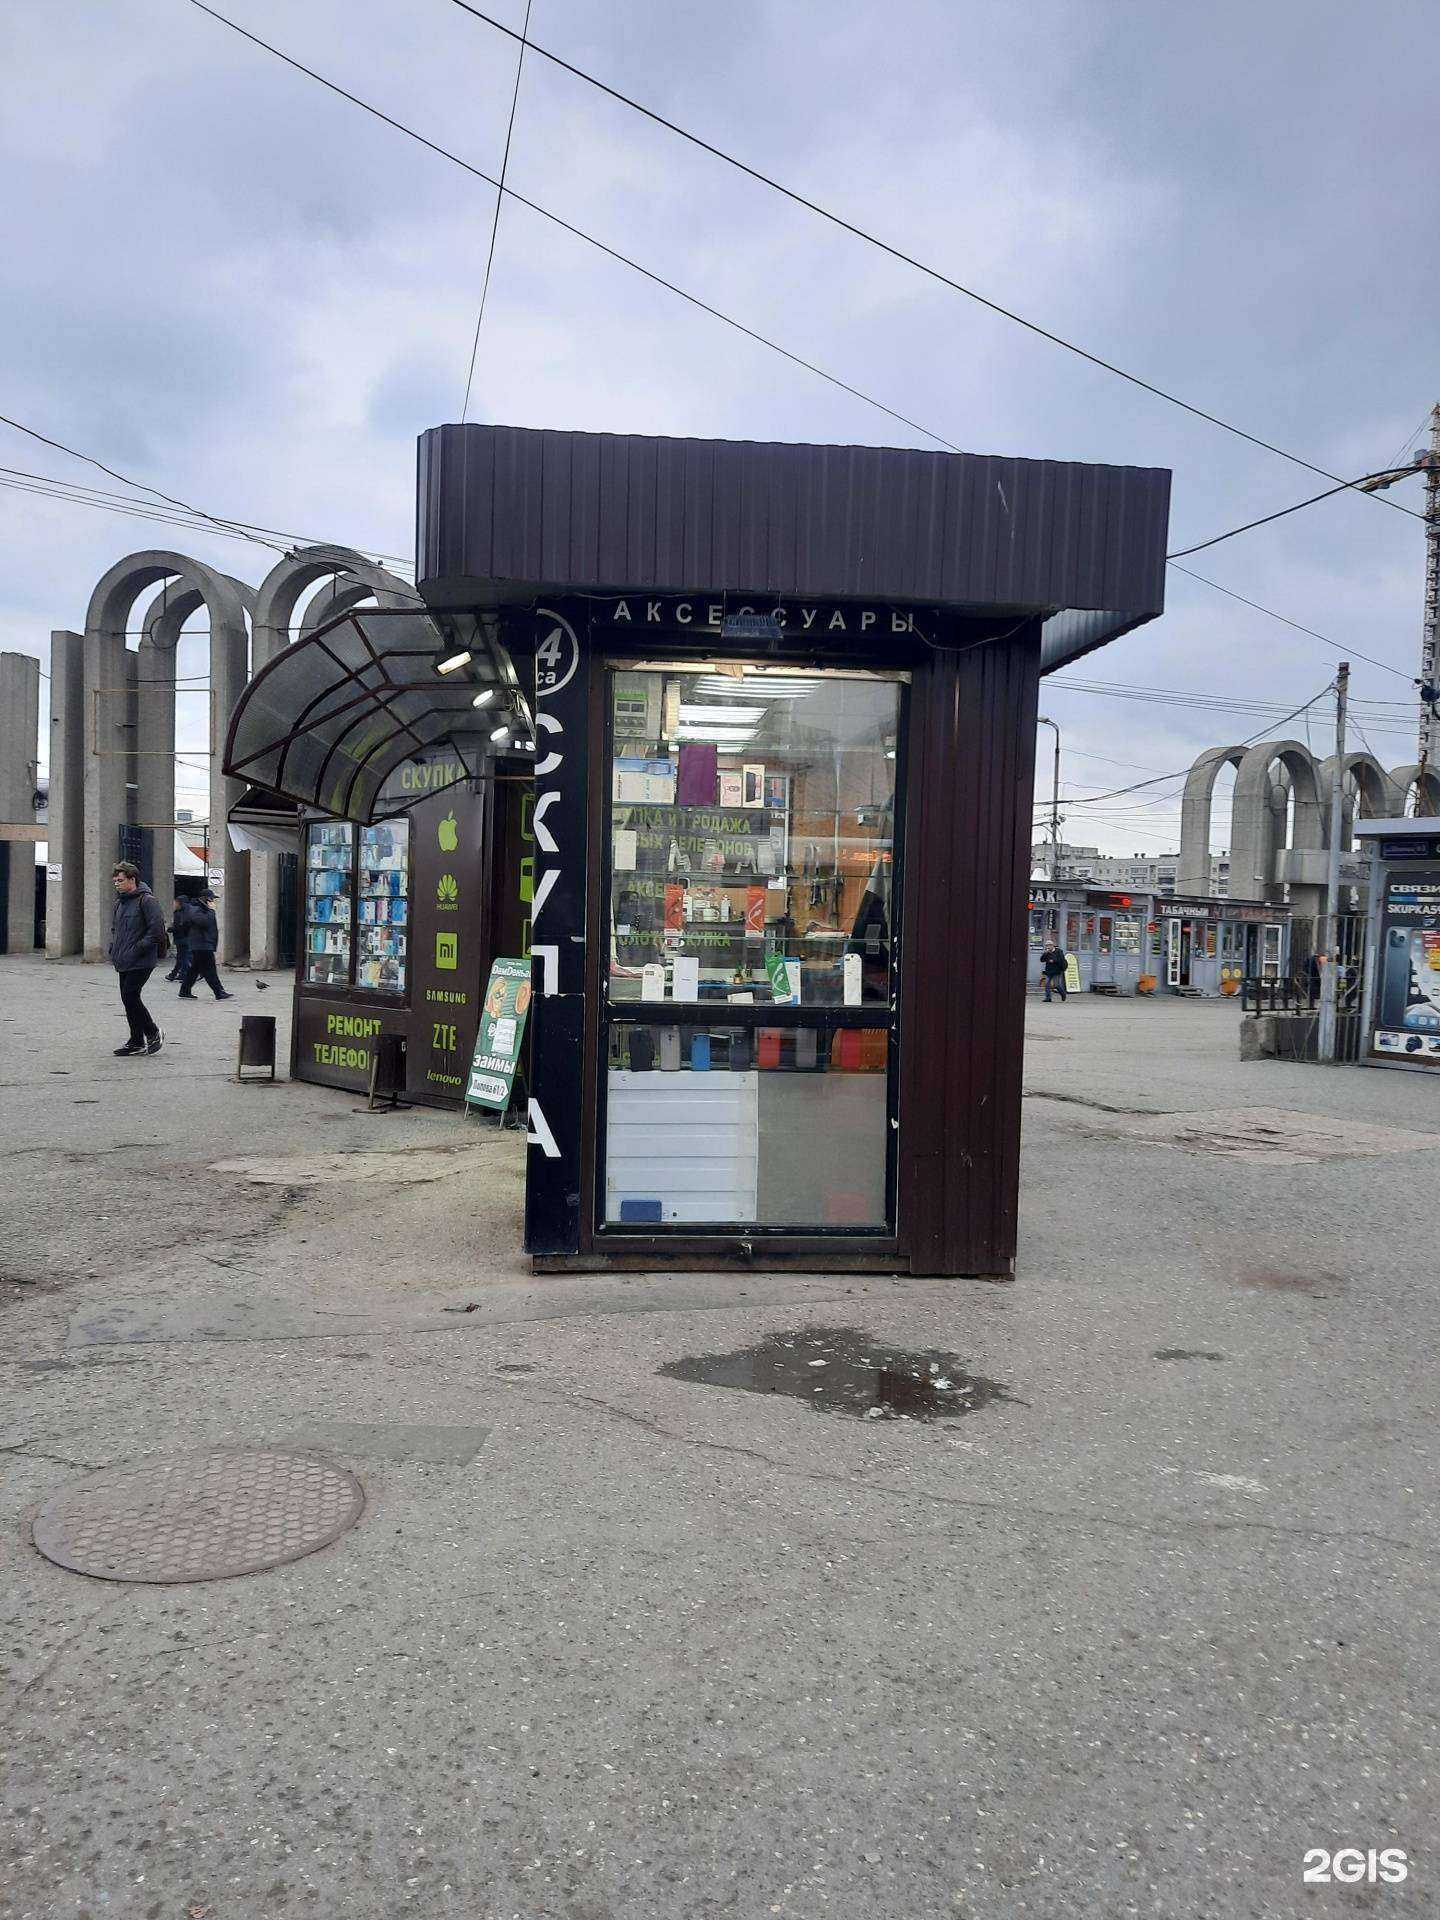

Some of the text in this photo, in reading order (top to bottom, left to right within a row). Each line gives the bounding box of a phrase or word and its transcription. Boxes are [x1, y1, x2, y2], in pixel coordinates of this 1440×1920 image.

[613, 600, 913, 632] АКСЕСУАРЫ
[669, 834, 752, 857] ЕЛЕОНОВ
[426, 989, 467, 1005] SAMSUNG
[327, 1014, 382, 1039] РЕМОНТ
[432, 1023, 457, 1051] ZTE
